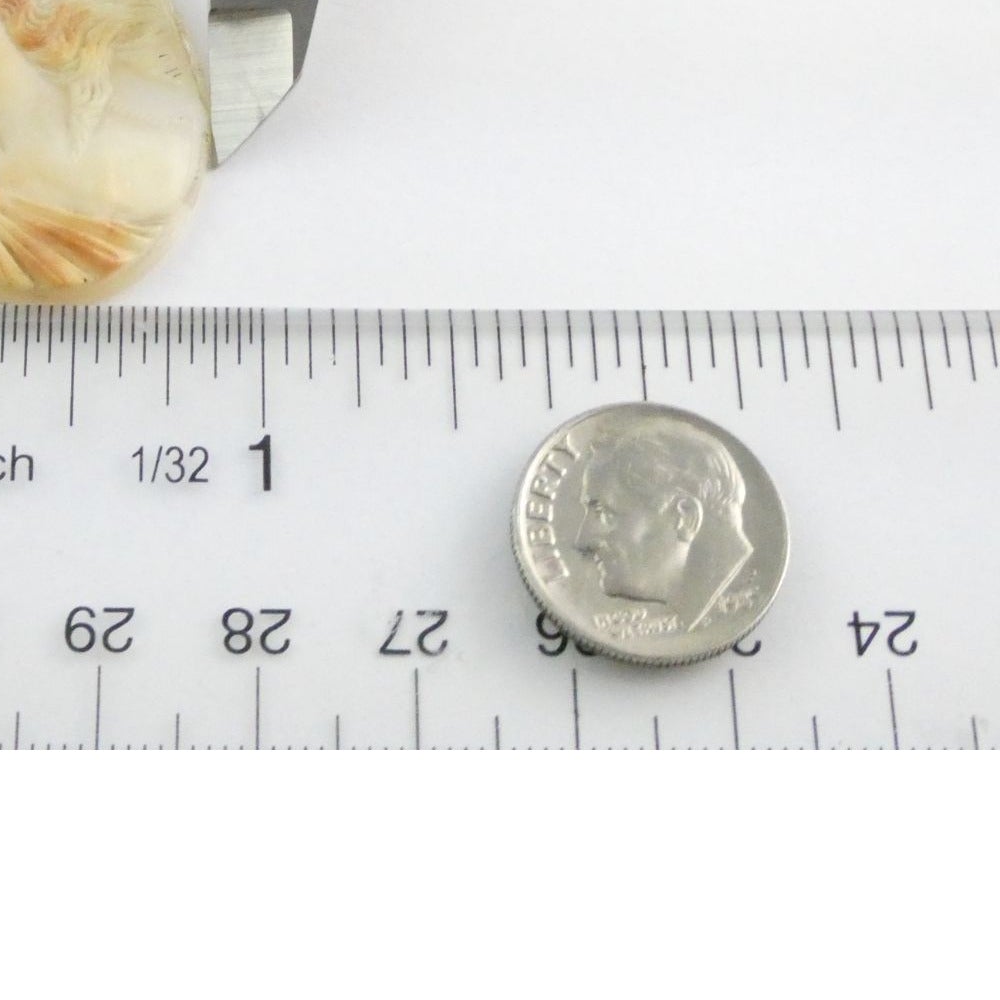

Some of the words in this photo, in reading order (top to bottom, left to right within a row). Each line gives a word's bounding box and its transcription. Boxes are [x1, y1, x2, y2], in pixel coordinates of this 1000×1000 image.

[131, 446, 210, 483] 1/32
[247, 434, 273, 492] 1
[64, 606, 136, 654] 29
[220, 607, 292, 655] 28
[378, 609, 449, 656] 27
[846, 610, 919, 657] 24
